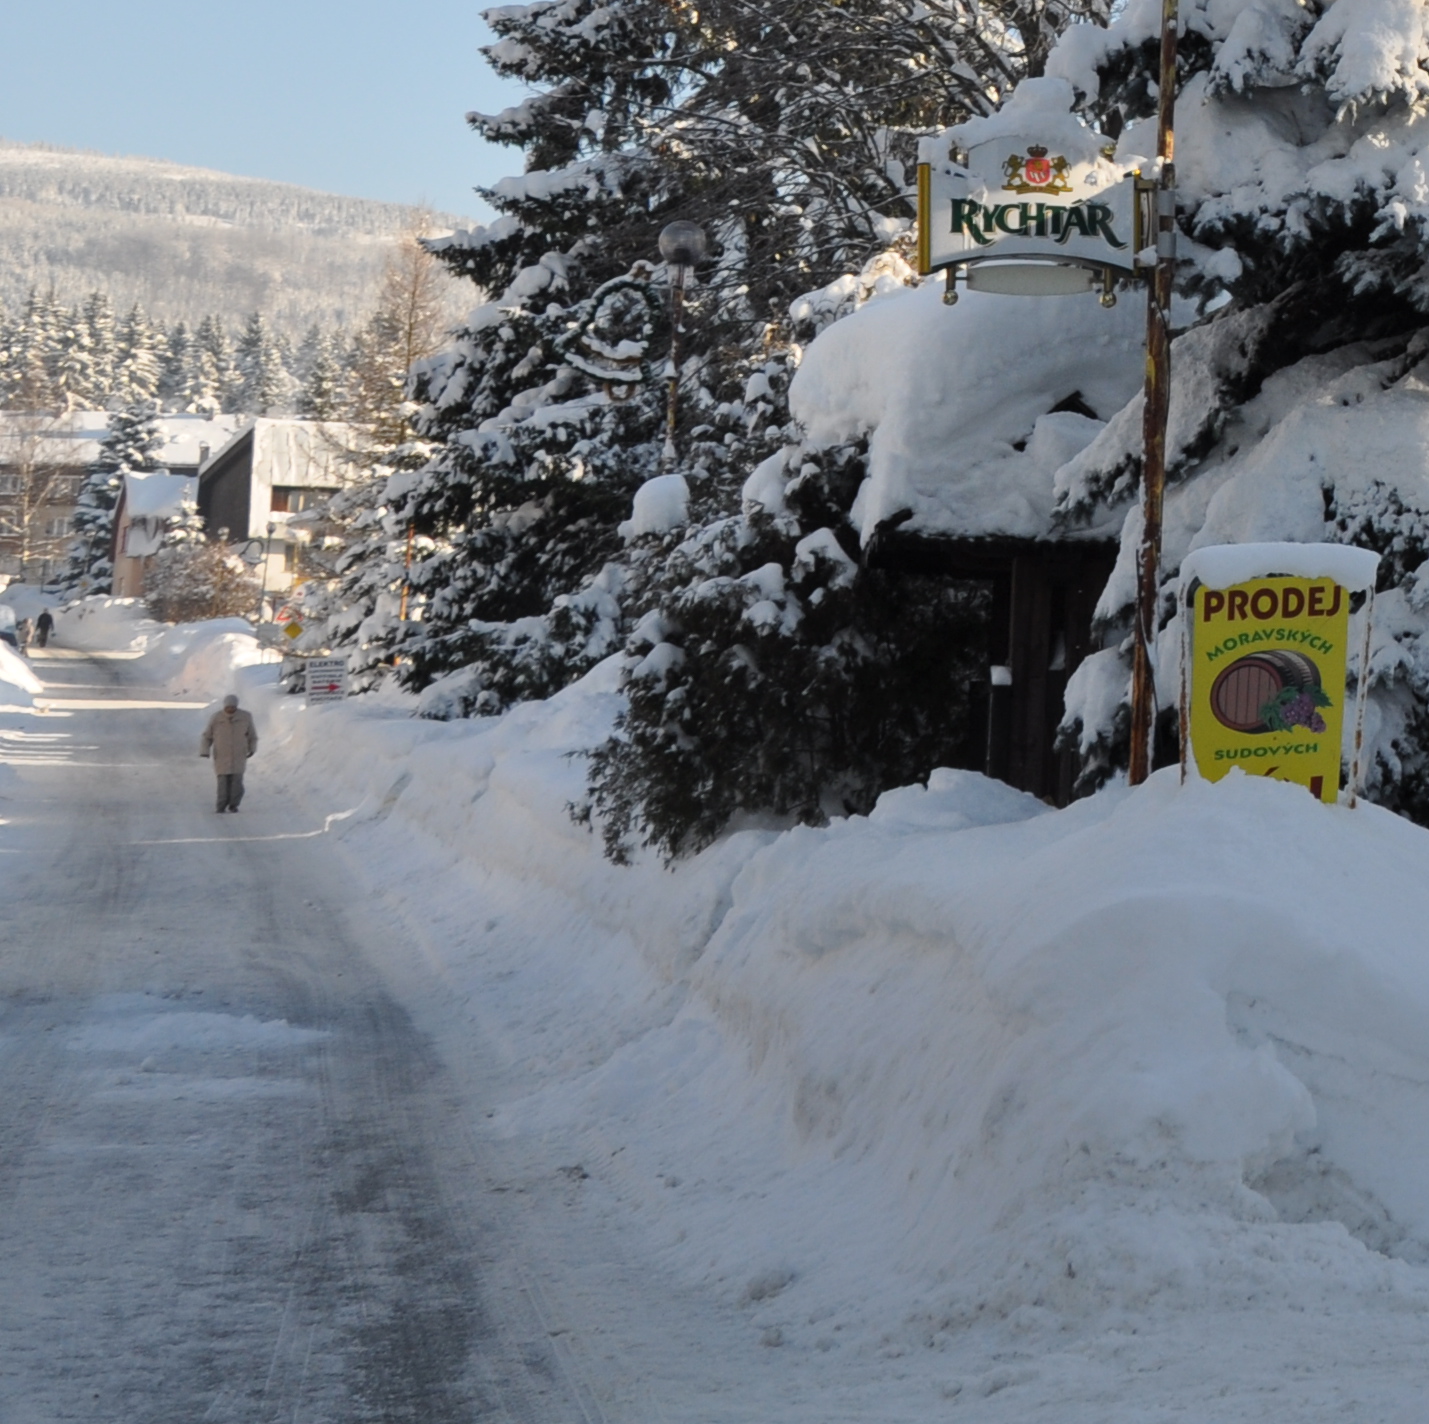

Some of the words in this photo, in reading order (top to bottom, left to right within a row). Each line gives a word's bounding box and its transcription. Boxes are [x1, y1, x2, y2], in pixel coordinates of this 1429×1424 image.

[1203, 584, 1342, 622] PRODEJ
[1205, 628, 1334, 662] MORAVSKÝCH
[1214, 741, 1319, 760] SUDOVÝCH
